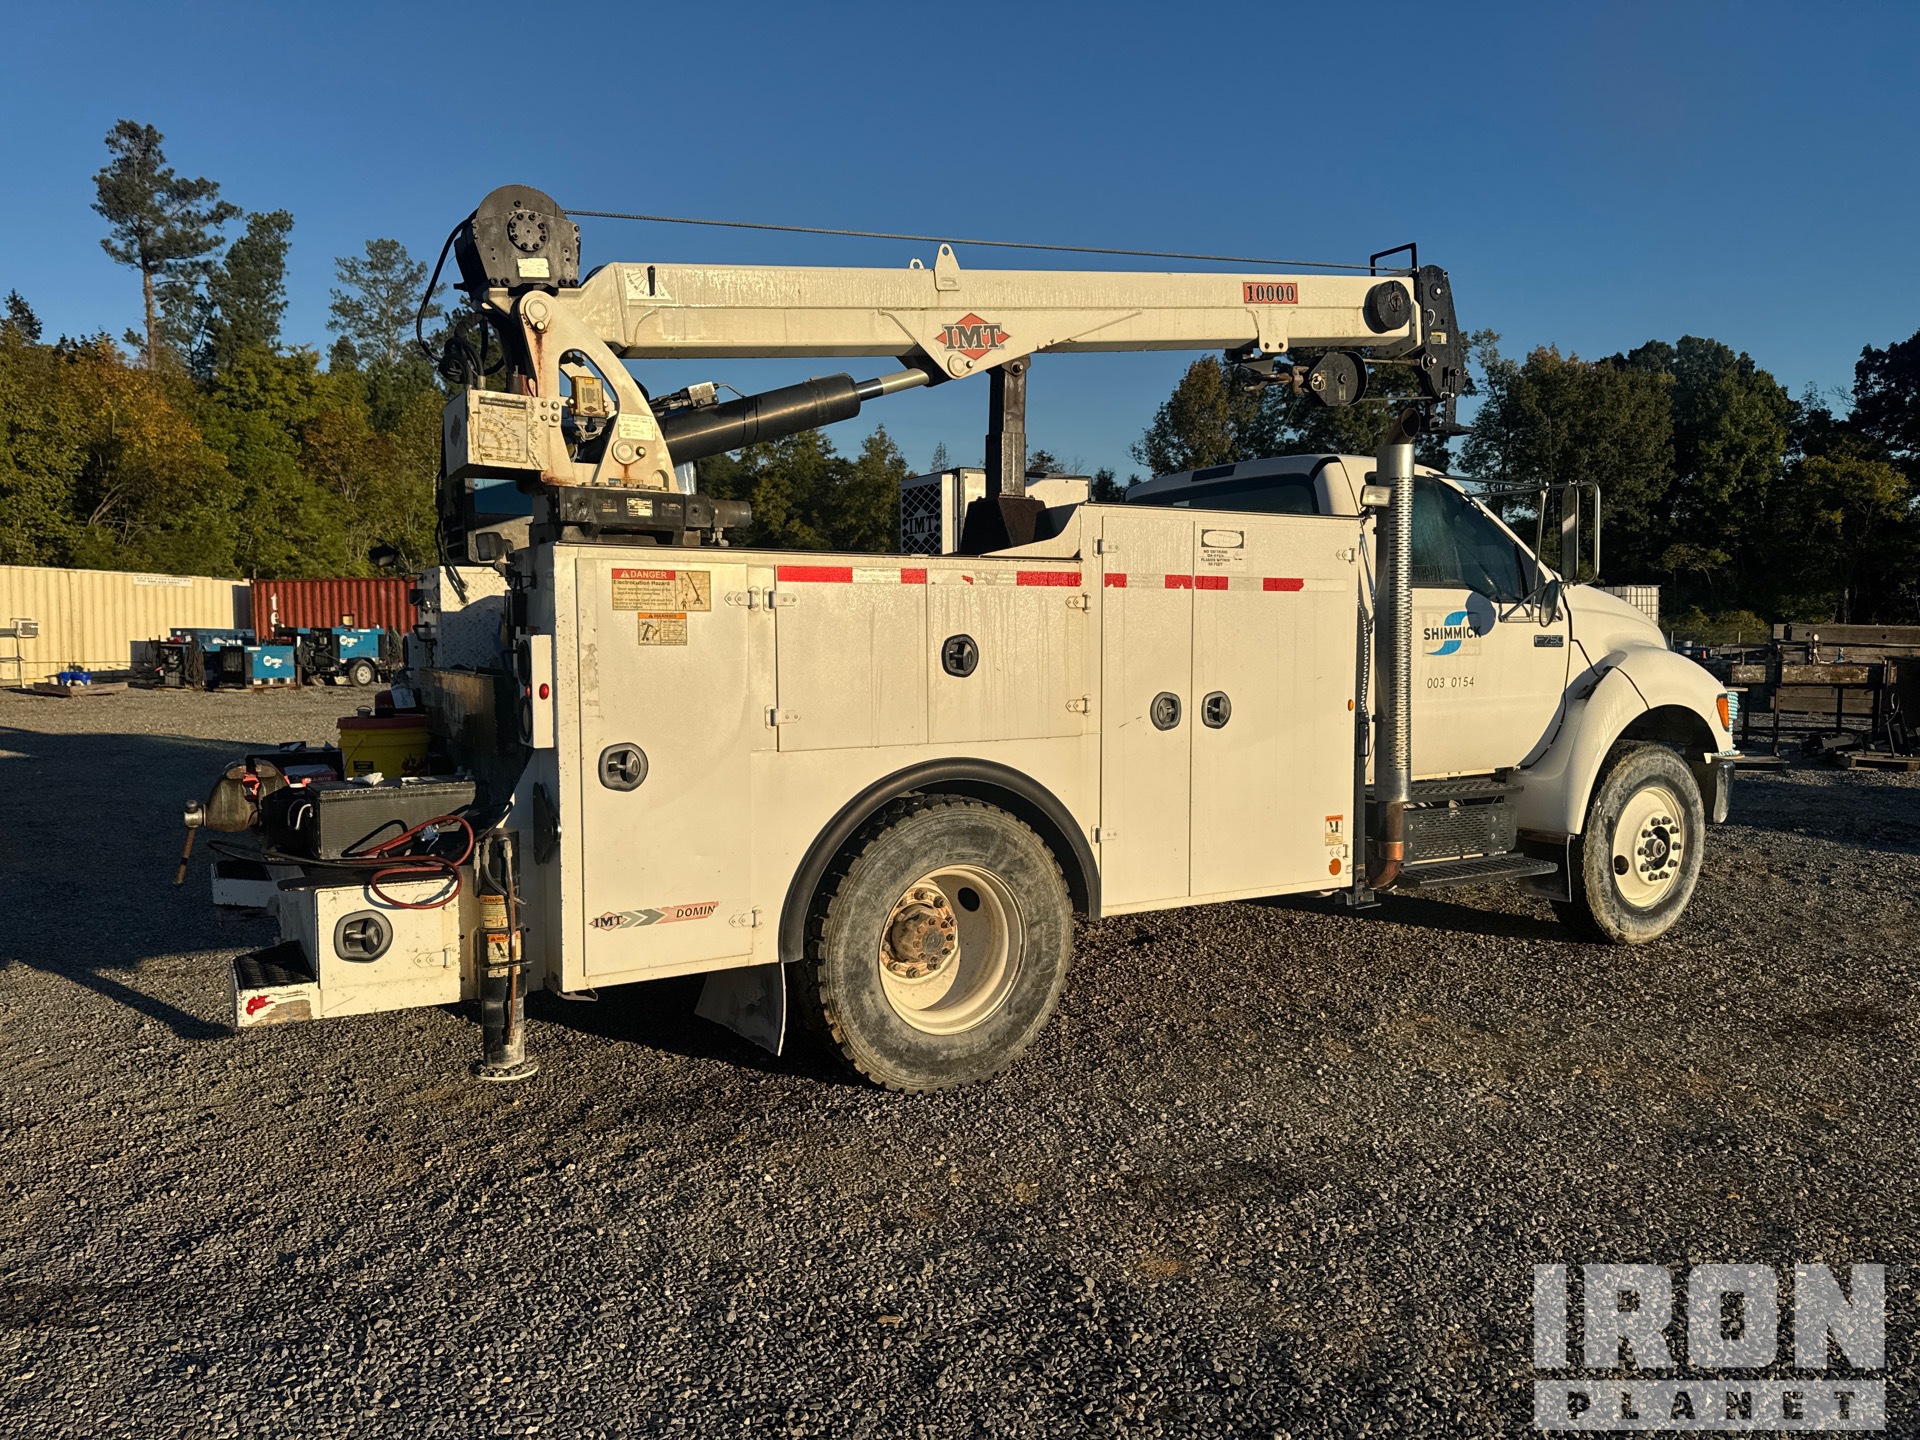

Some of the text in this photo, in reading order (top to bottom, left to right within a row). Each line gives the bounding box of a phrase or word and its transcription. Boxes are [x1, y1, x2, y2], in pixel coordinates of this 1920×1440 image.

[1247, 285, 1294, 302] 10000
[942, 322, 1002, 352] IMT
[908, 515, 934, 535] IMT
[630, 571, 667, 579] DANGER
[1423, 626, 1482, 641] SHIMMICK
[1427, 676, 1475, 689] 003 0154
[676, 905, 716, 918] DOMIN
[593, 915, 623, 928] IMT
